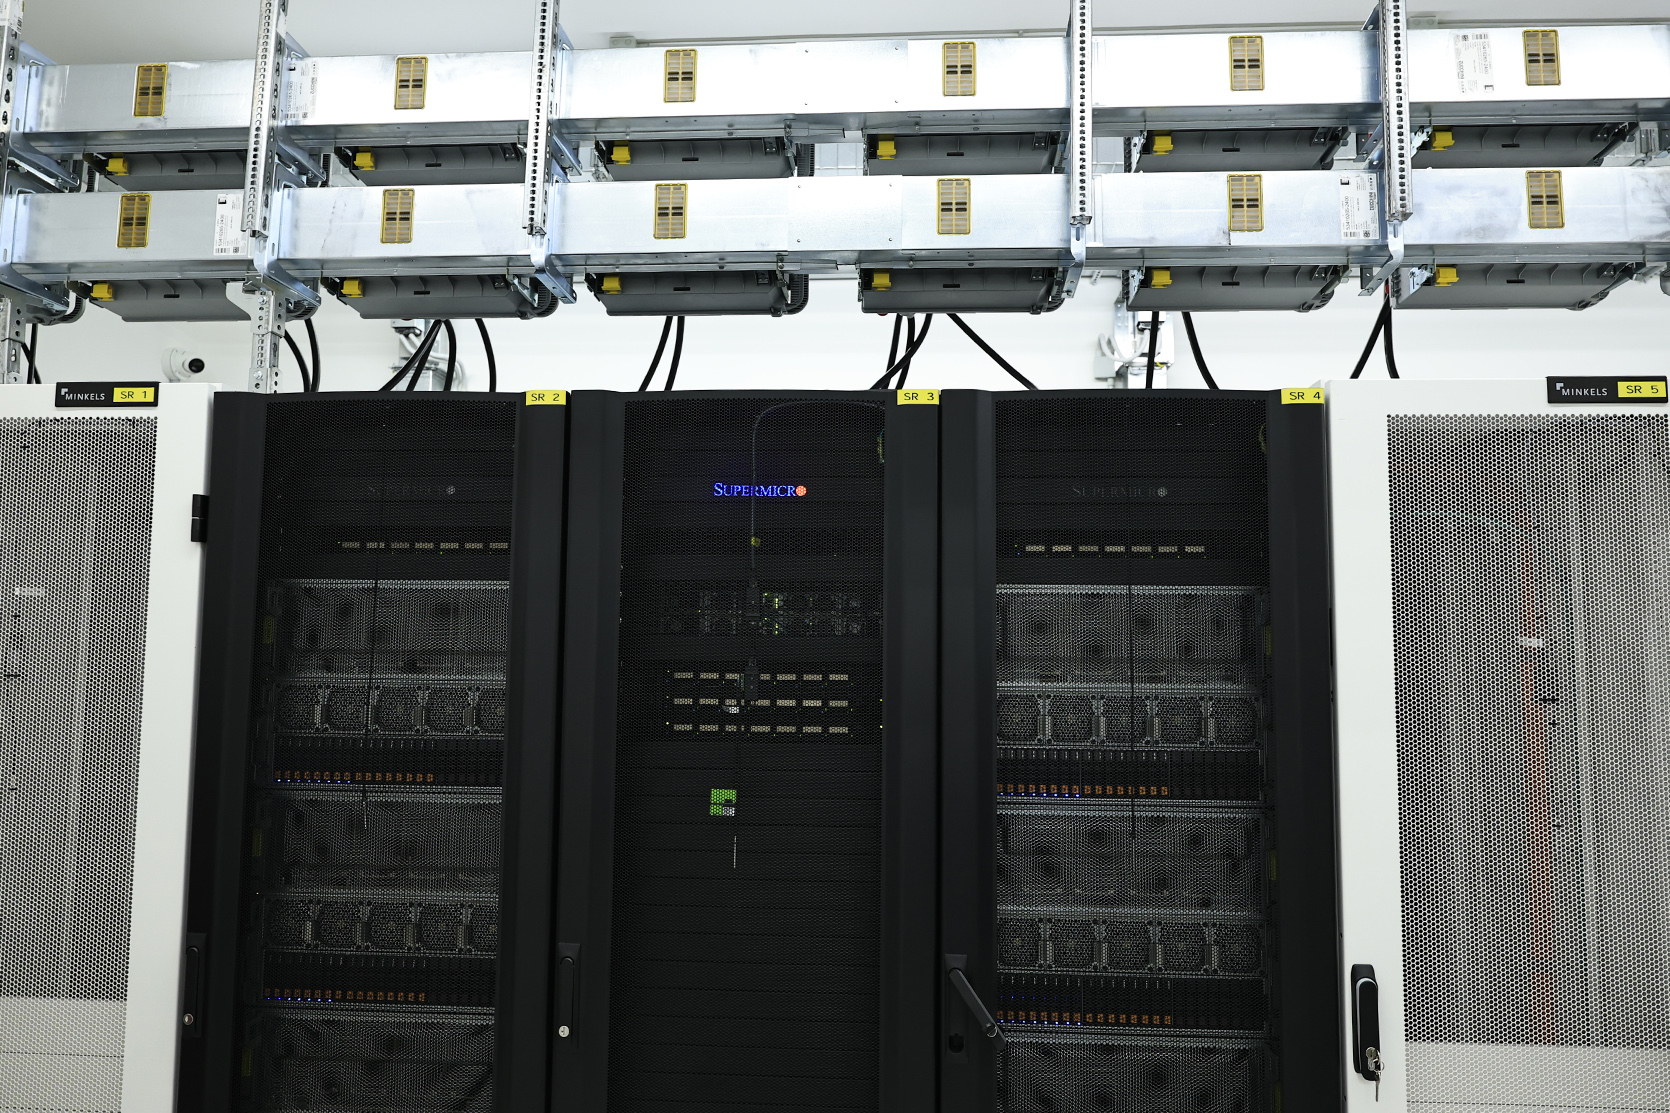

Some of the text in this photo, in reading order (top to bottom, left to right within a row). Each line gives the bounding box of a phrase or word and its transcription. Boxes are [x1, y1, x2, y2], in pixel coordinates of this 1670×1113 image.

[1562, 388, 1608, 396] MINKELS
[1626, 384, 1659, 394] SR 5
[65, 393, 105, 401] MINKELS
[120, 390, 147, 399] SR 1
[531, 392, 560, 402] SR 2
[903, 392, 935, 401] SR 3
[1289, 391, 1321, 401] SR 4
[713, 482, 807, 497] SUPERMICRO
